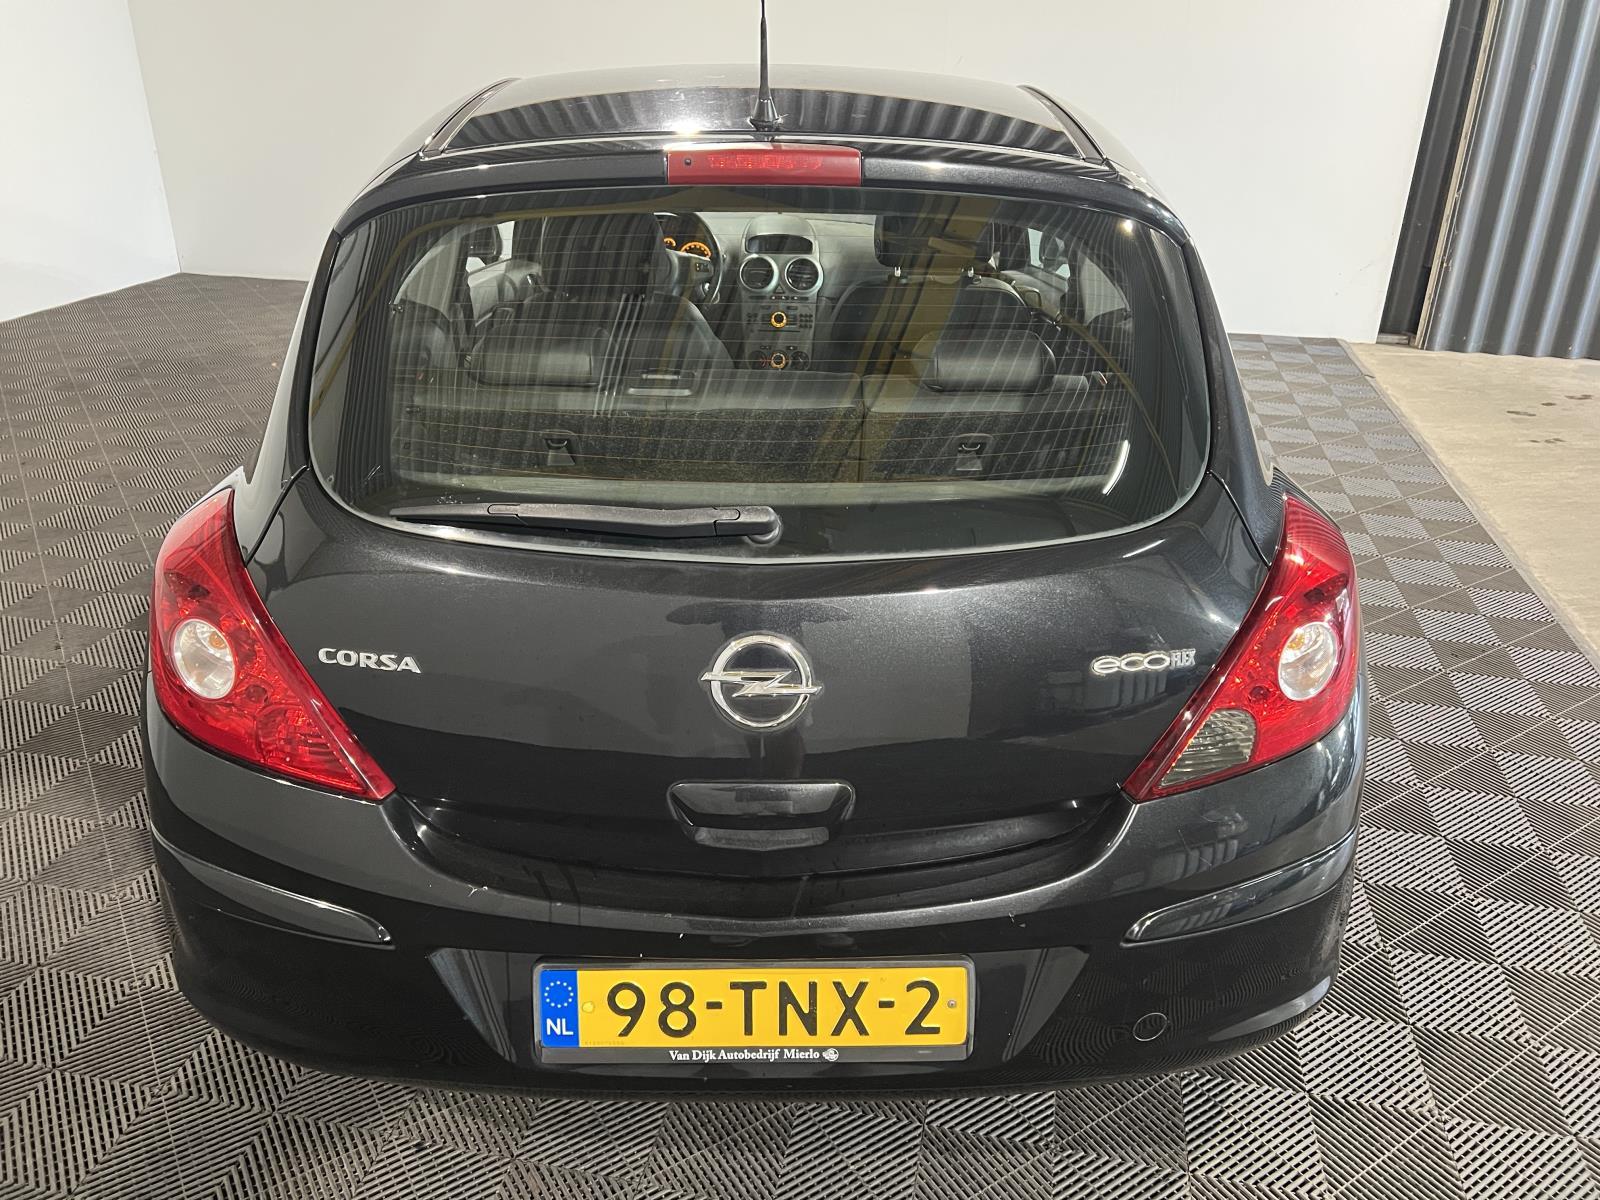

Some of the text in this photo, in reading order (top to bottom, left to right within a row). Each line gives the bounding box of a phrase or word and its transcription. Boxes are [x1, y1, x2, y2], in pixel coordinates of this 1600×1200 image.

[318, 648, 421, 673] CORSA
[606, 980, 941, 1039] 98-TNX-2
[546, 1018, 574, 1036] NL
[669, 1048, 820, 1063] Van Dijk Autobedrijf Mierlo
